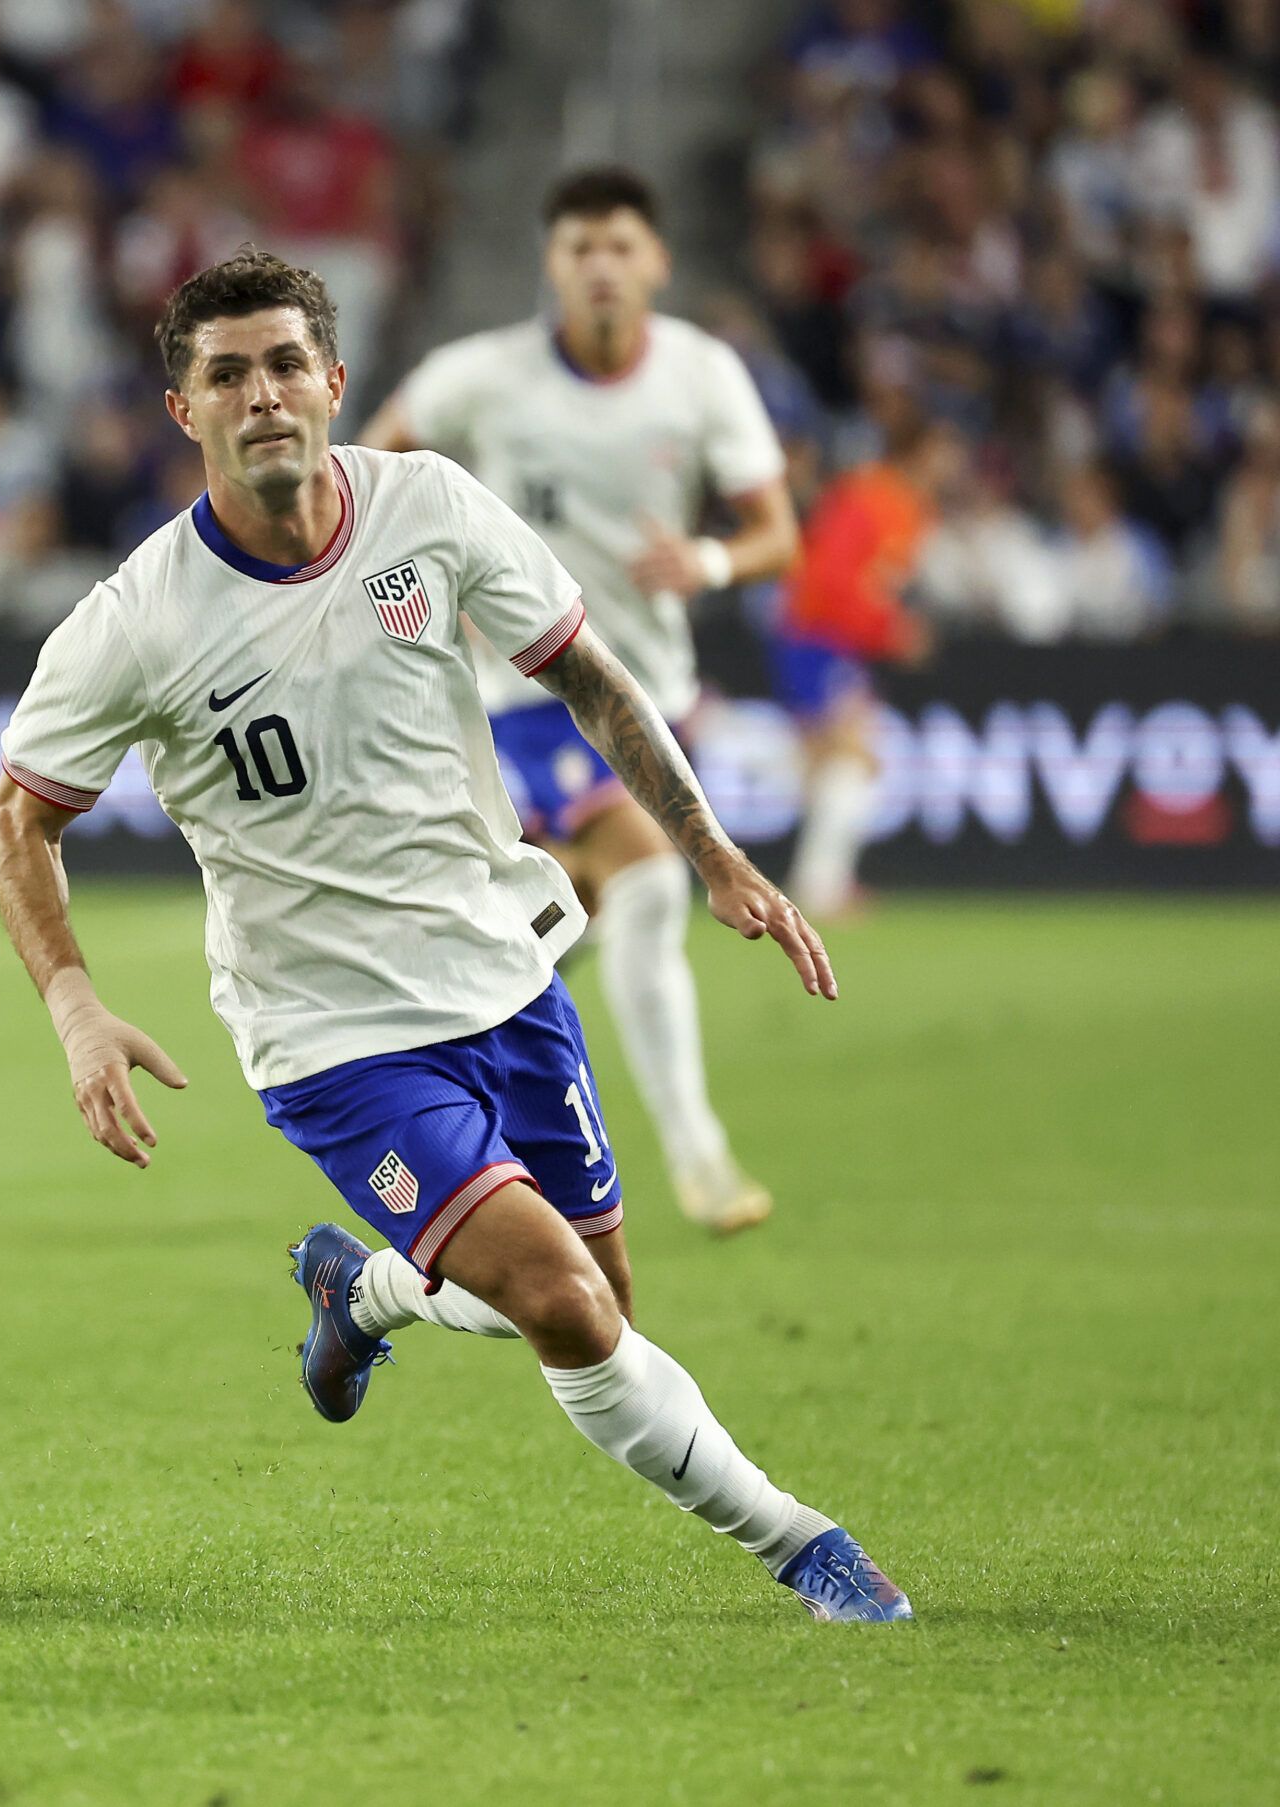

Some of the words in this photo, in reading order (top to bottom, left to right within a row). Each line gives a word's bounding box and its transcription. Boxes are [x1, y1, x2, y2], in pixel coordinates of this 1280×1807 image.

[369, 566, 417, 602] USA
[213, 714, 307, 801] 10
[372, 1155, 400, 1191] USA
